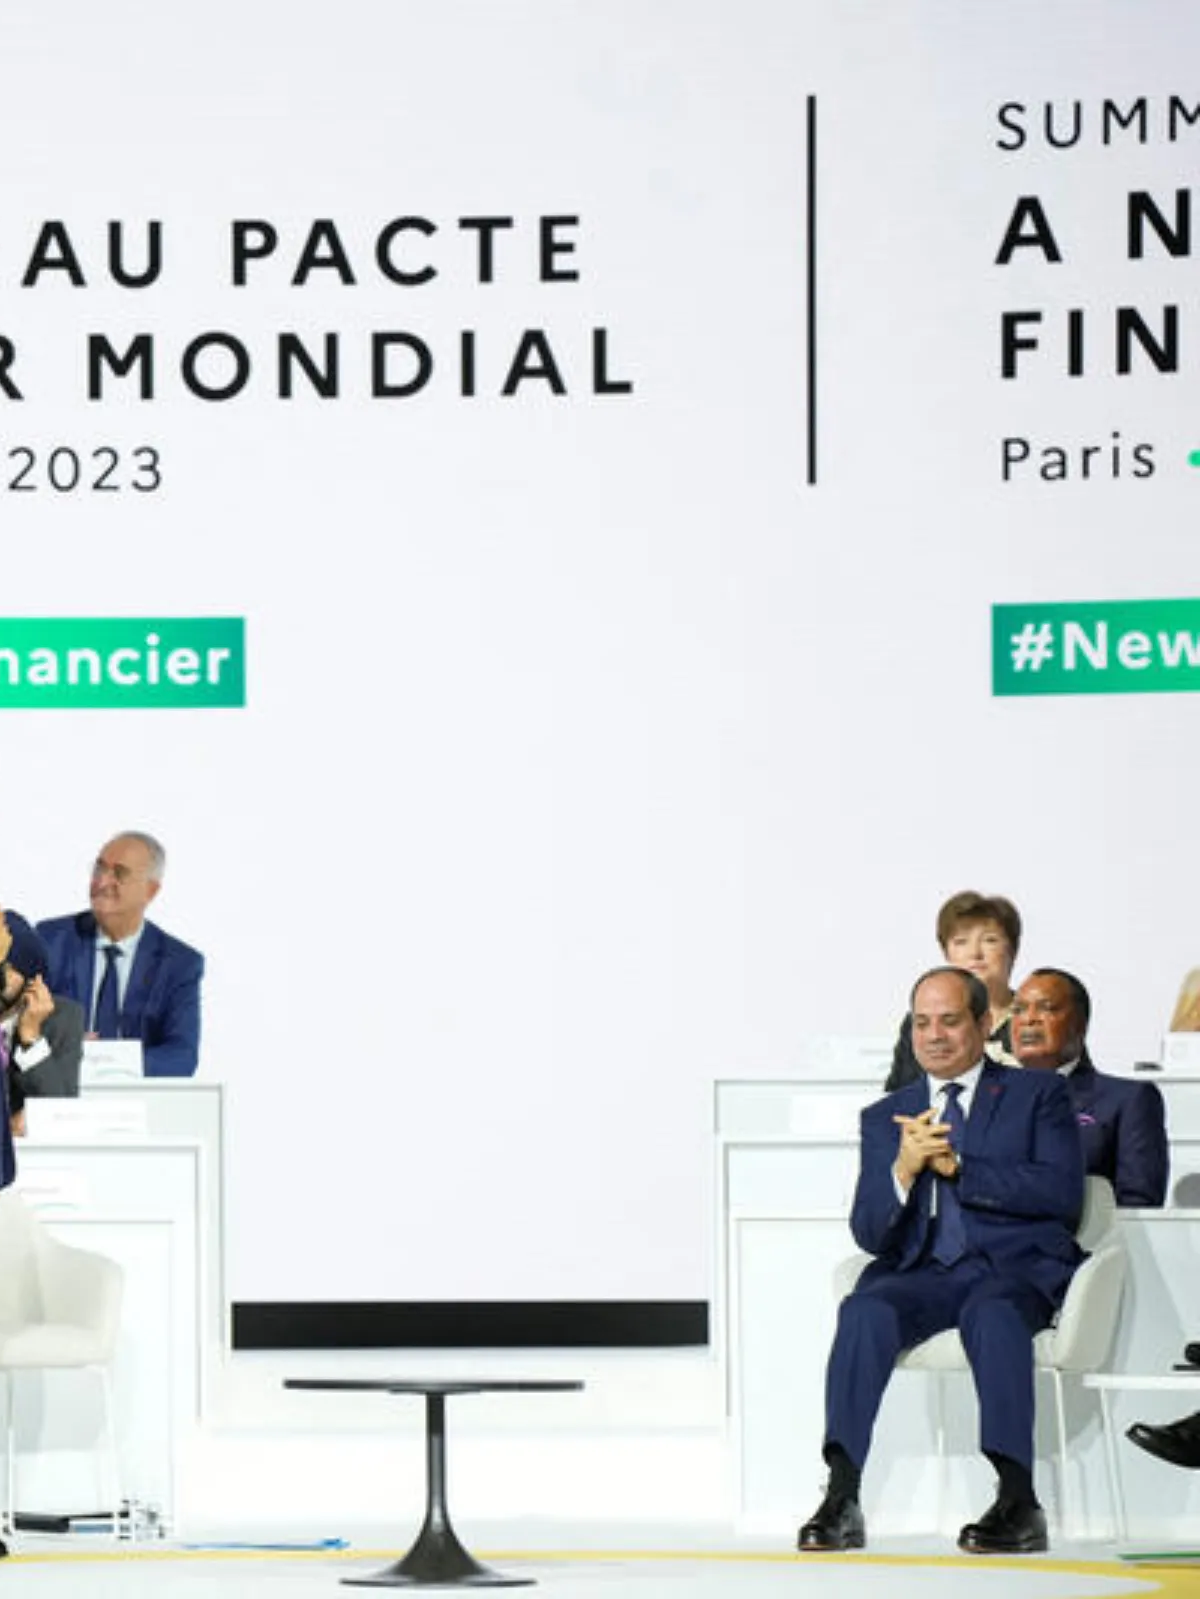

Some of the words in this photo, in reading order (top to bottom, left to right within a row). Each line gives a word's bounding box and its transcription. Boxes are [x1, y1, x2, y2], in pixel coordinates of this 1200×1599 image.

[232, 215, 582, 288] PACTE
[994, 195, 1063, 265] A
[88, 326, 633, 403] MONDIAL
[1001, 304, 1179, 380] FIN
[8, 446, 161, 492] 2023
[1002, 431, 1155, 482] Paris
[1011, 621, 1200, 672] #New
